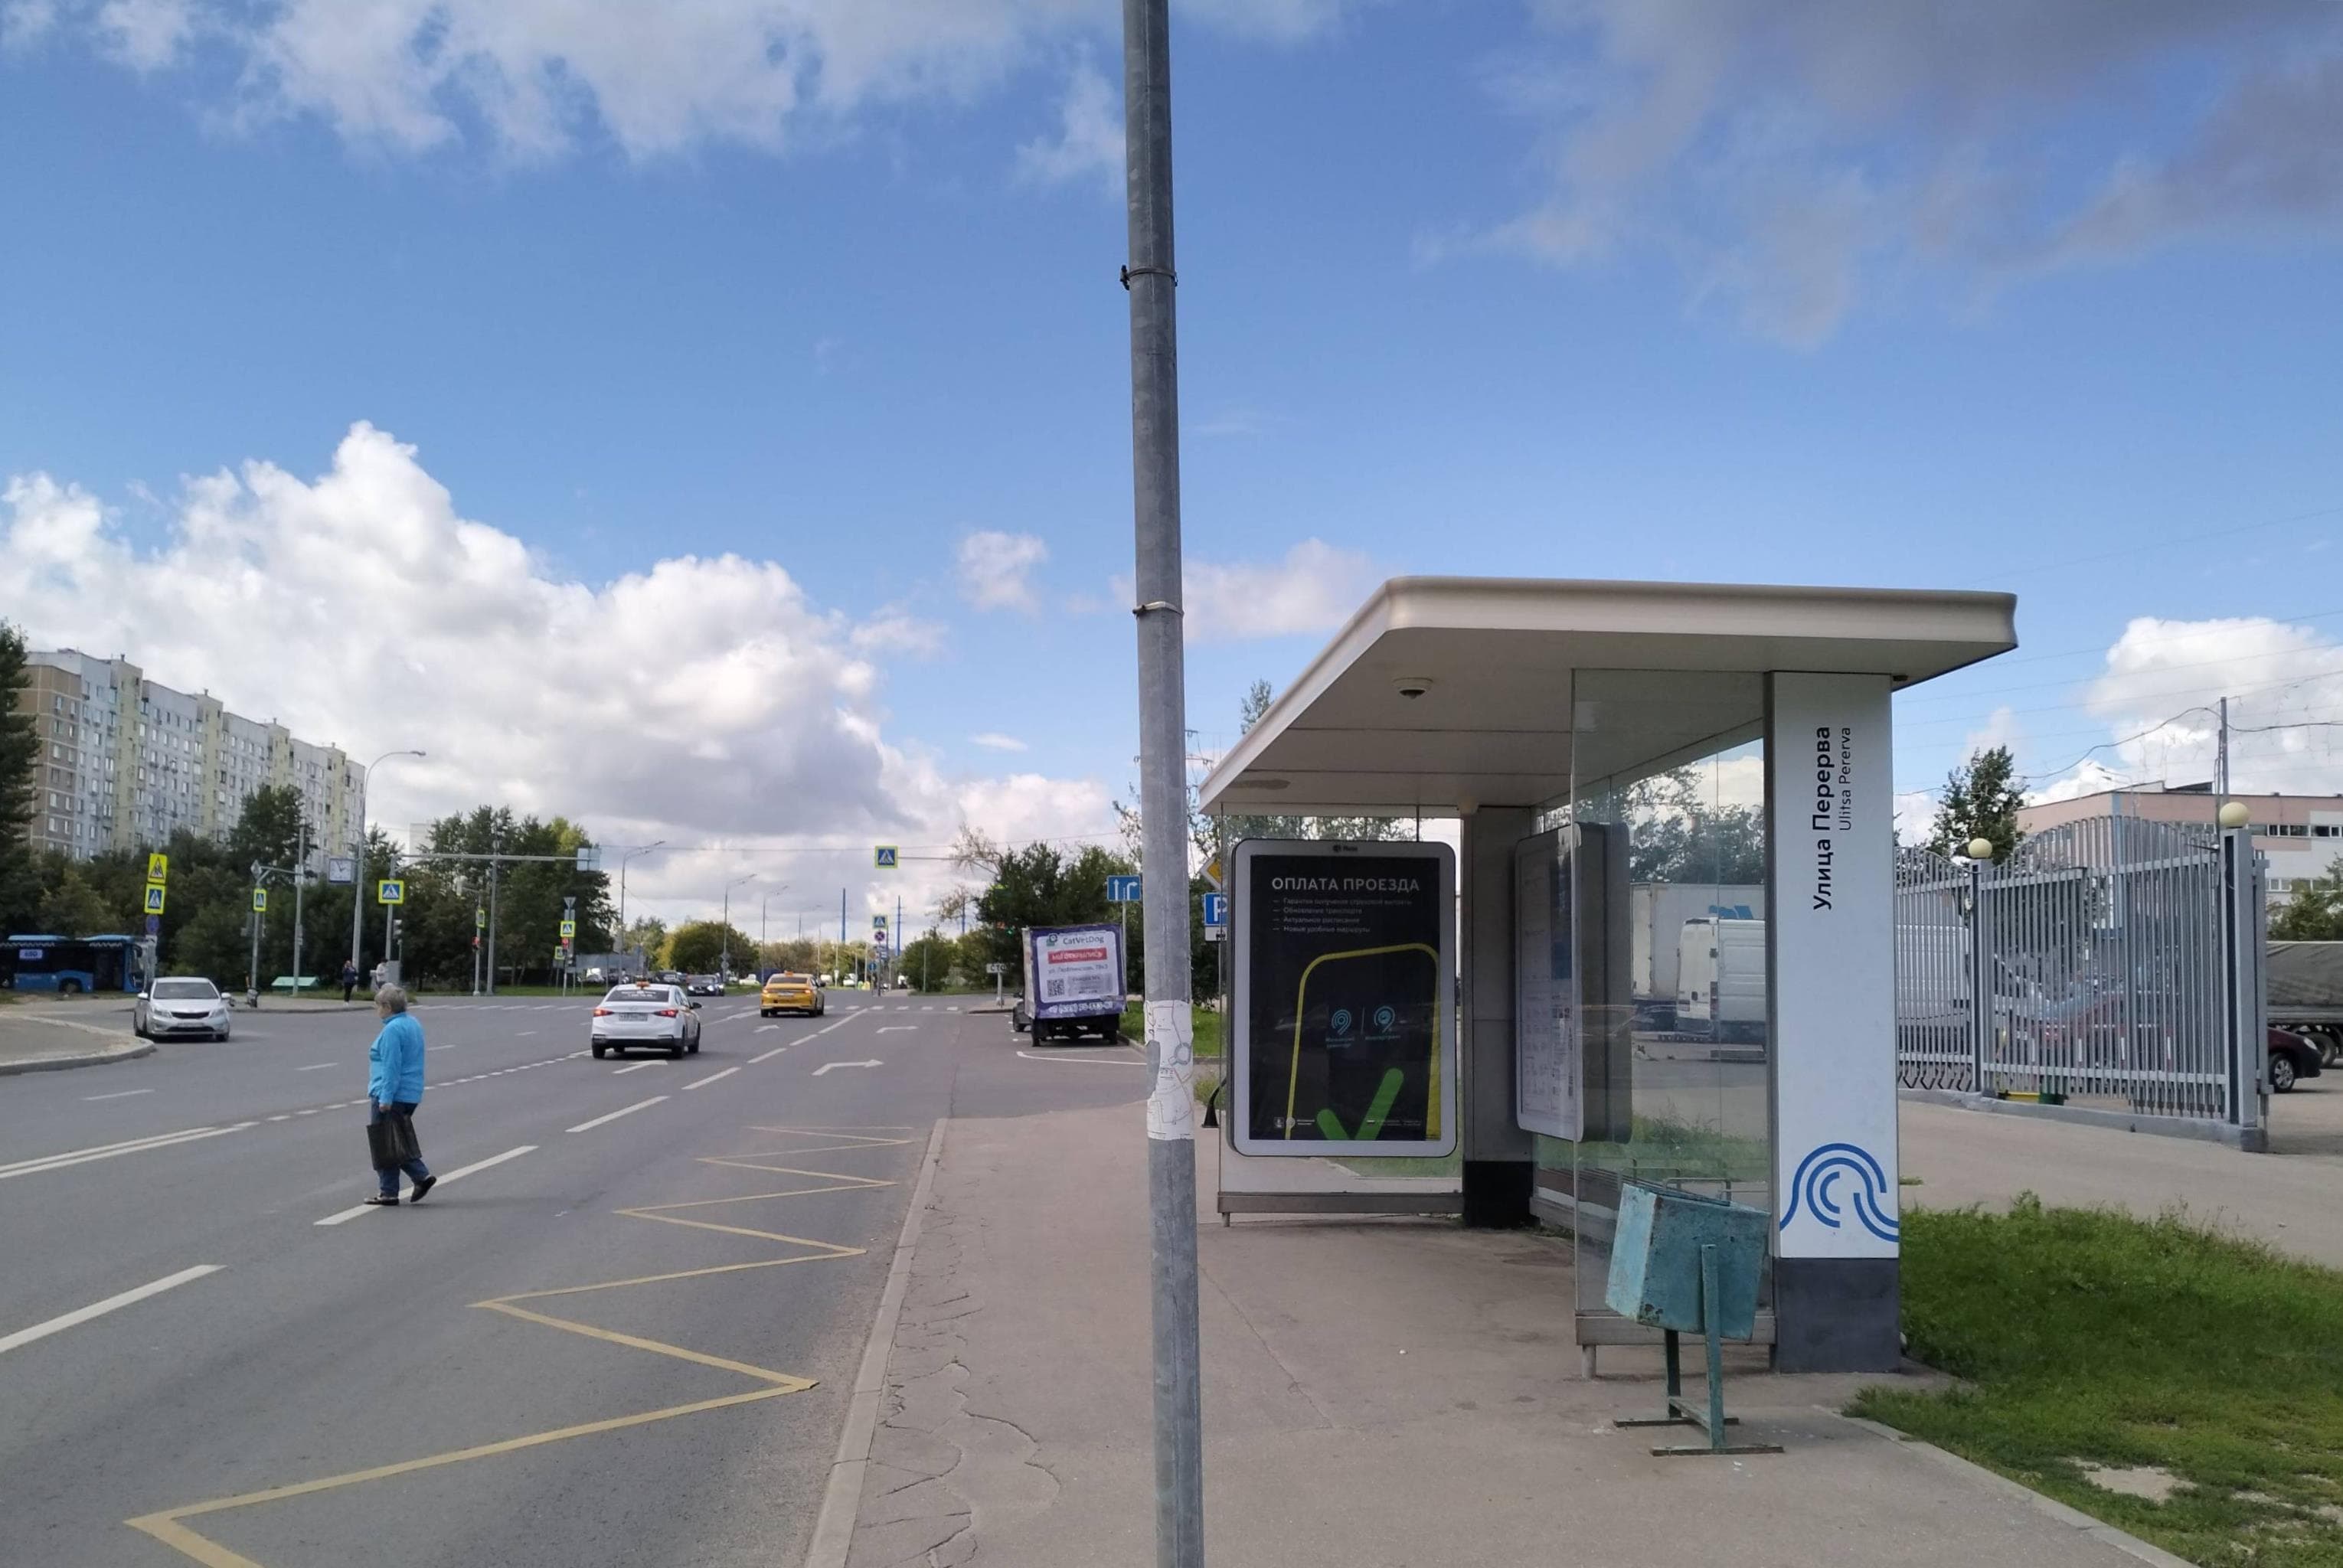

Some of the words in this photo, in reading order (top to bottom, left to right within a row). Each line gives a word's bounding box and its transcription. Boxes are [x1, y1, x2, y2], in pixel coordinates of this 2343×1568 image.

[1812, 727, 1835, 831] Перерва
[1838, 727, 1851, 784] Pererva
[1838, 789, 1851, 831] Ulitsa
[1272, 877, 1338, 890] ОПЛАТА
[1344, 878, 1420, 893] ПРОЕЗДА
[1813, 838, 1834, 910] Улица
